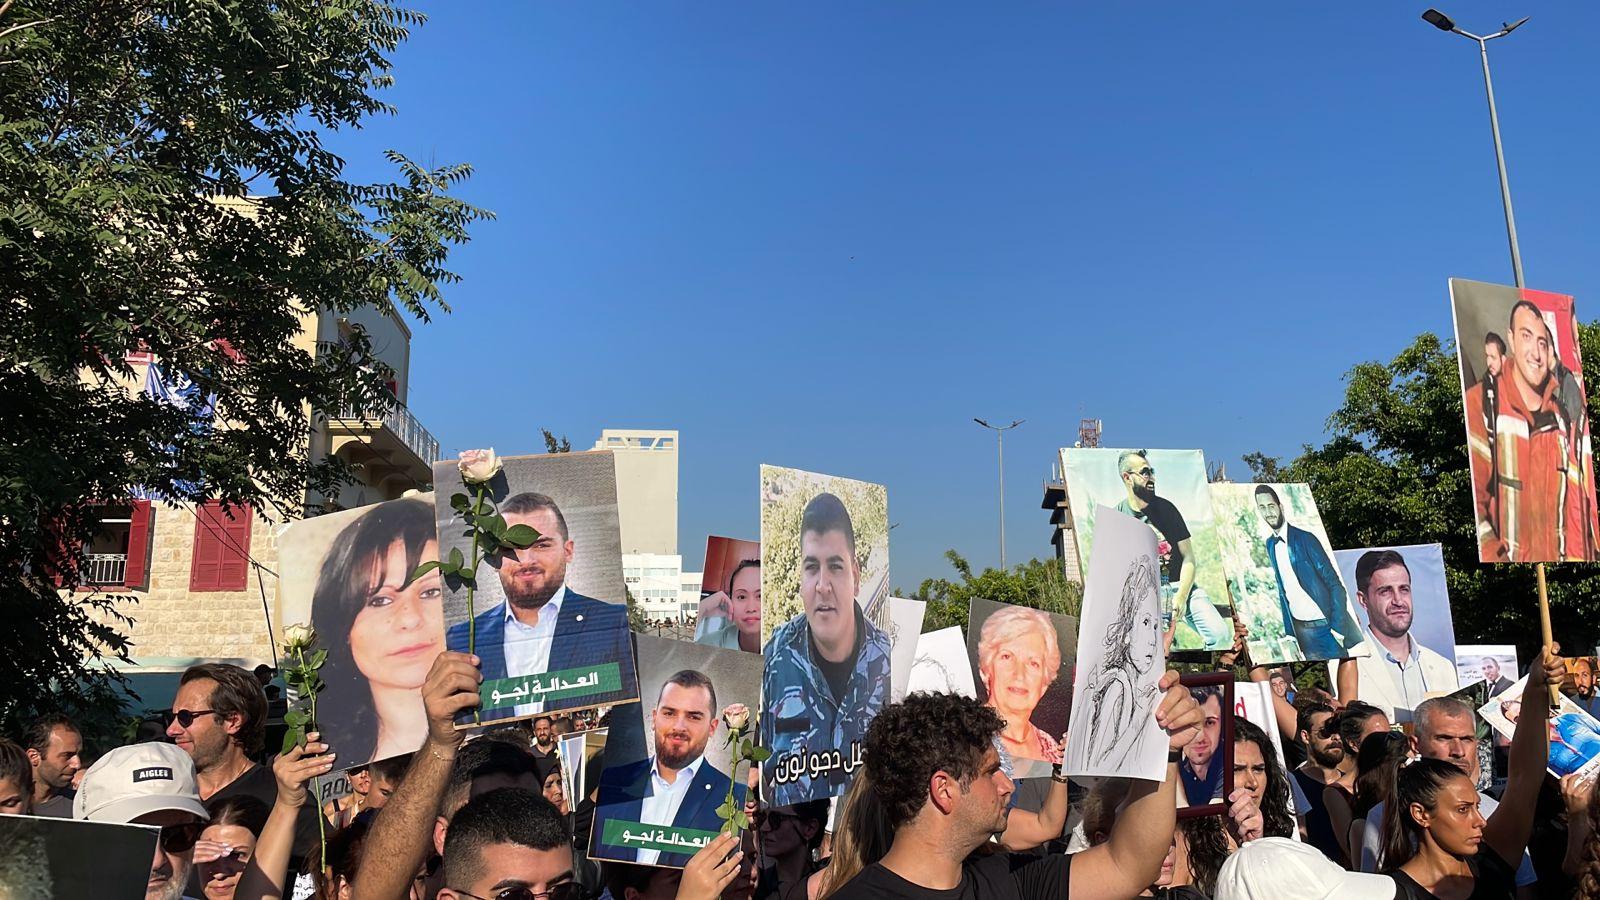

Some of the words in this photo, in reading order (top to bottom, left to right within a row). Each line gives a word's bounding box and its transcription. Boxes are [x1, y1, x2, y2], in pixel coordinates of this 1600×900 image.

[491, 682, 530, 704] لجو
[532, 671, 599, 694] العدالة
[139, 769, 165, 779] AIGLE
[775, 747, 807, 783] نون
[622, 829, 655, 845] لجو
